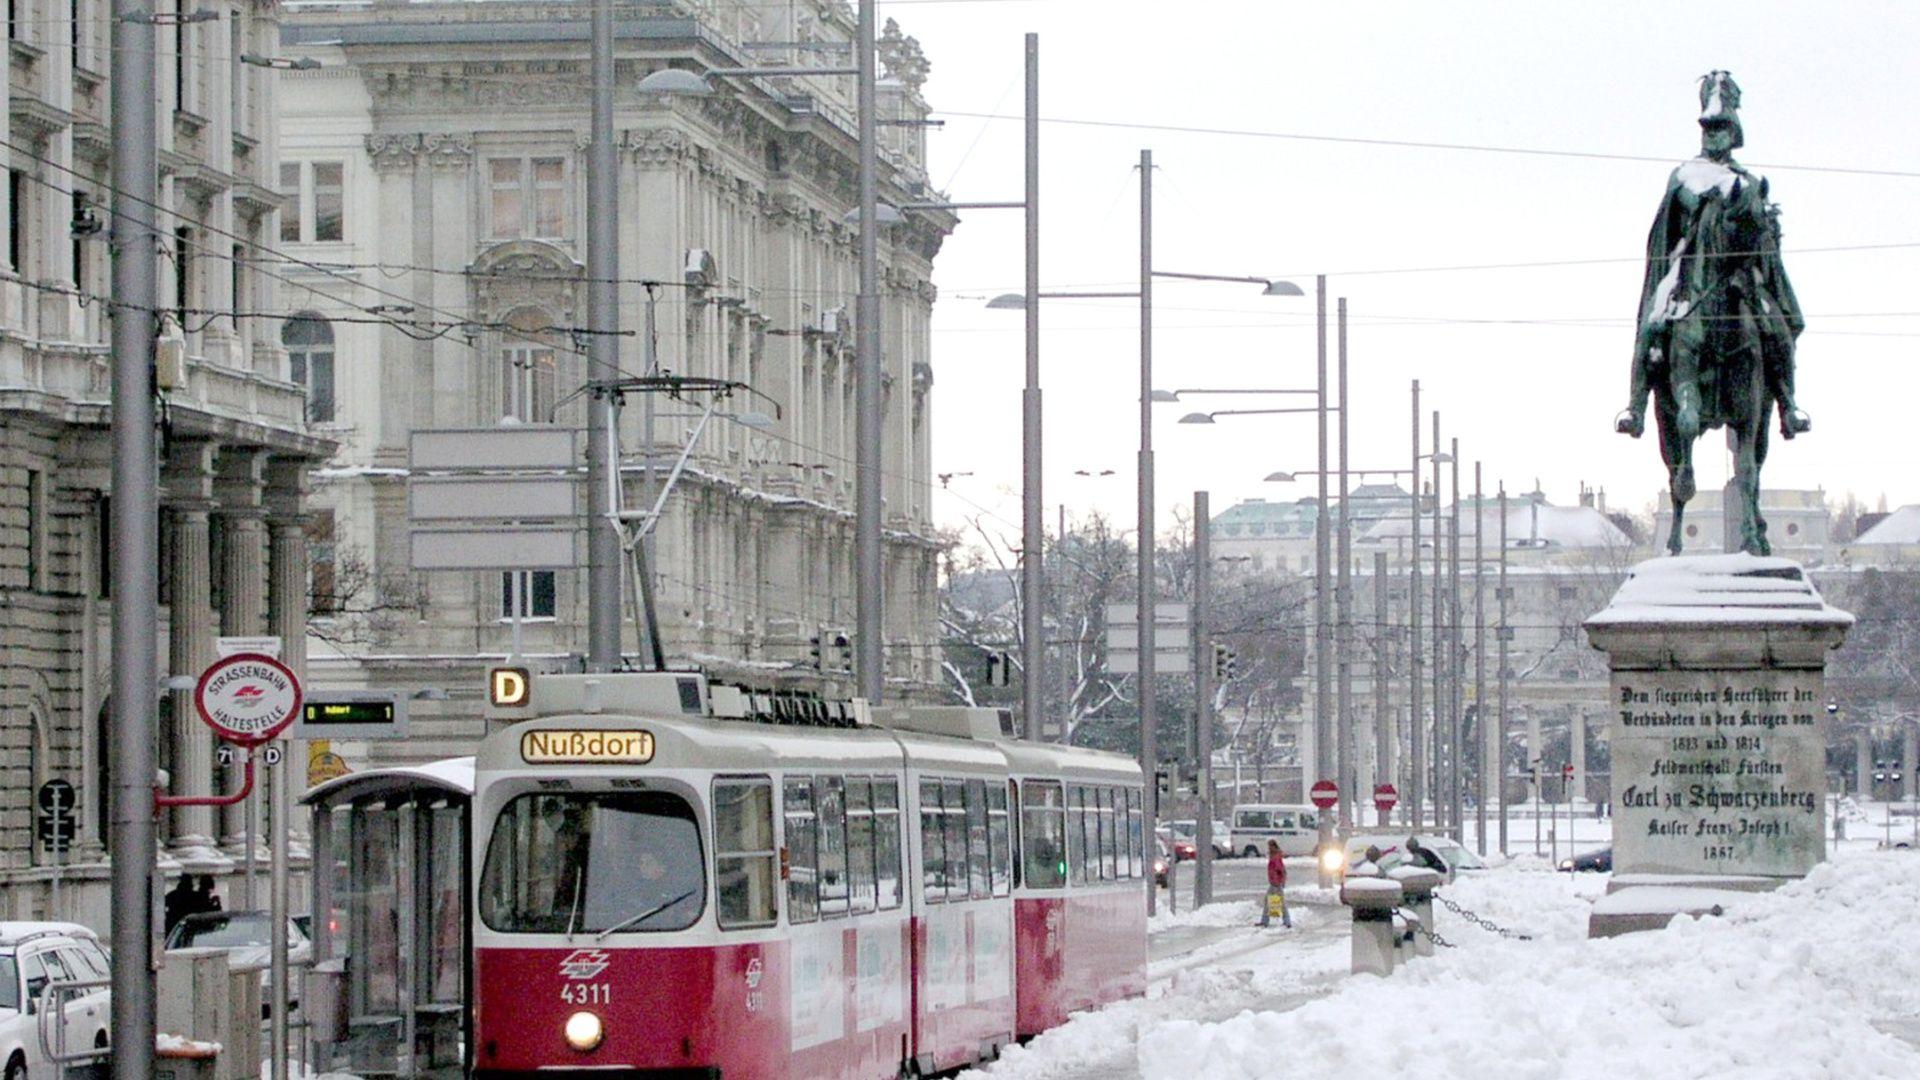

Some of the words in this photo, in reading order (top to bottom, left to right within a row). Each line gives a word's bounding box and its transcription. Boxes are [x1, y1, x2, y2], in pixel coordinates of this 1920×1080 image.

[209, 665, 288, 695] STRASSENBAHN
[496, 671, 525, 703] D
[1620, 686, 1649, 703] Dem
[1794, 686, 1813, 702] der
[214, 705, 285, 730] HALTESTELLE
[385, 706, 391, 719] 1
[1700, 713, 1711, 727] in
[1715, 710, 1735, 727] den
[1793, 714, 1814, 726] von
[529, 732, 648, 756] Nußdorf
[1706, 734, 1728, 750] und
[218, 749, 233, 763] 71
[267, 749, 280, 763] D
[1622, 785, 1658, 808] Carl
[1666, 792, 1682, 811] zu
[1689, 785, 1815, 814] Schwarzenberg
[560, 983, 611, 1004] 4311
